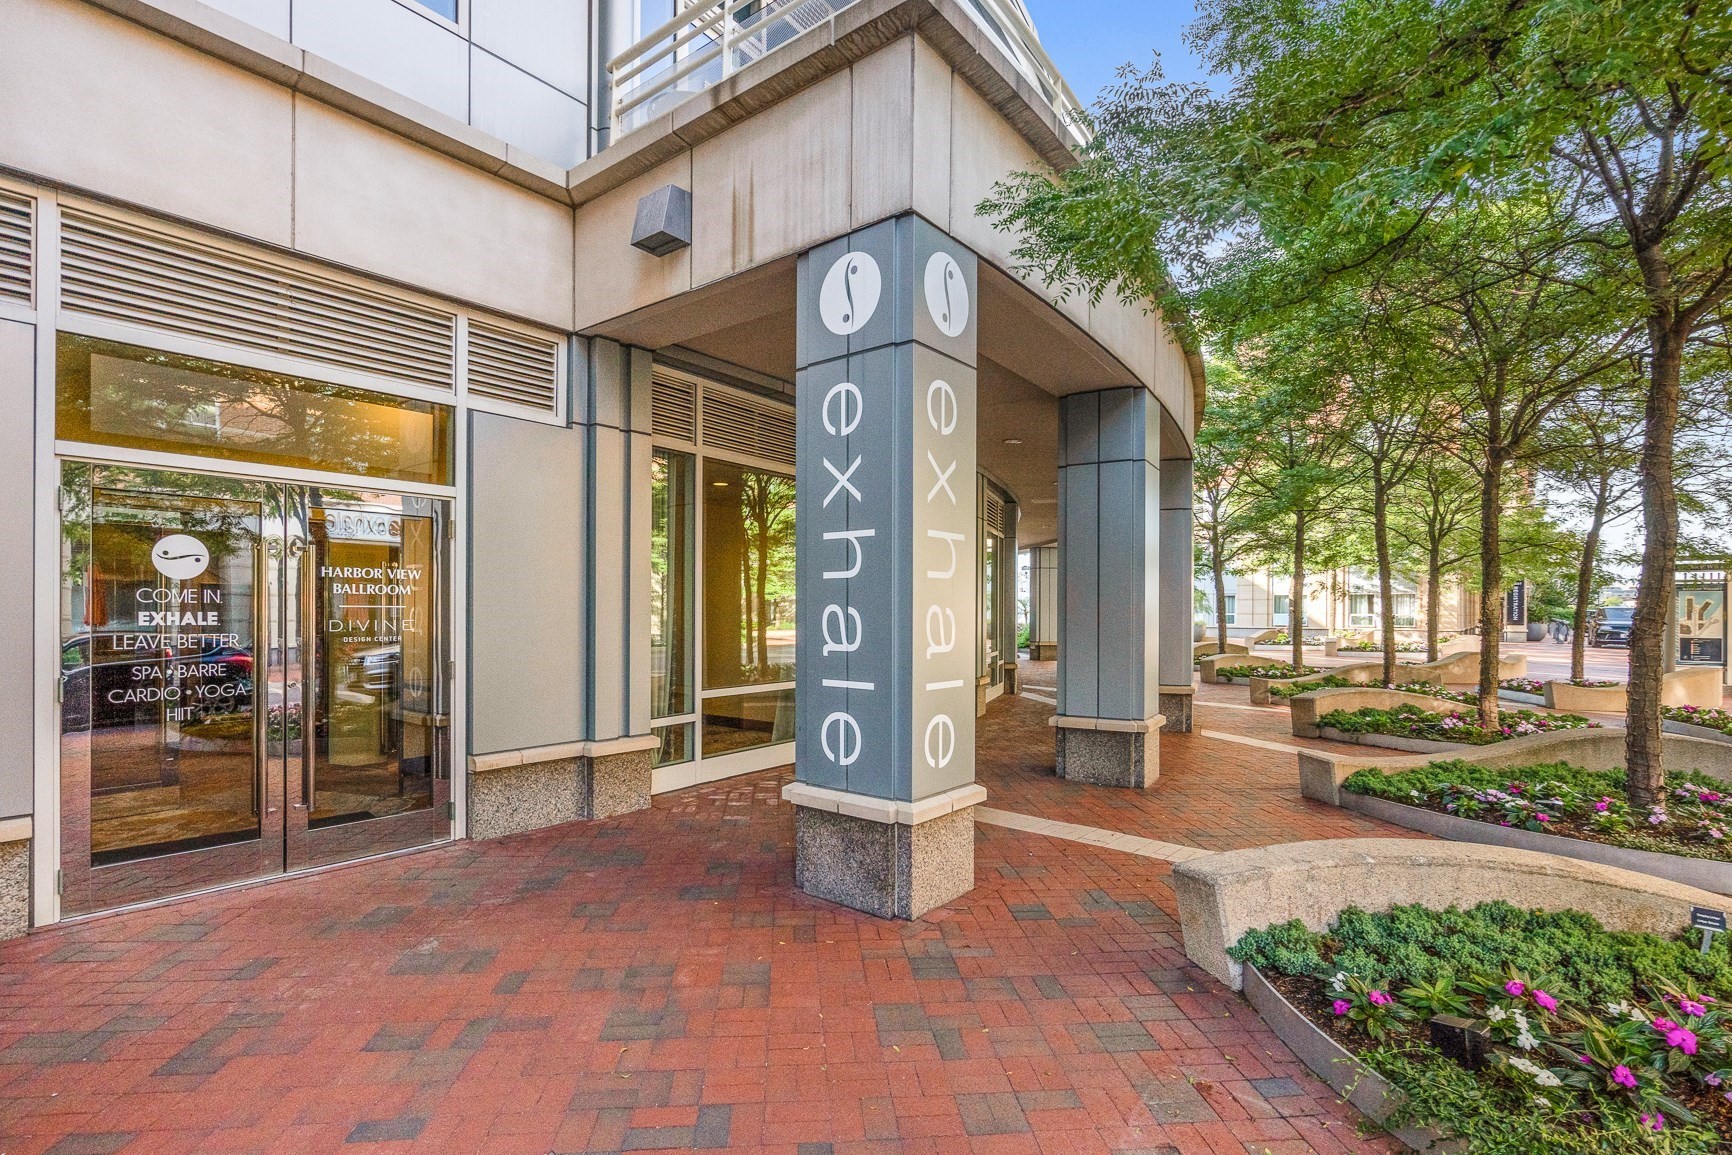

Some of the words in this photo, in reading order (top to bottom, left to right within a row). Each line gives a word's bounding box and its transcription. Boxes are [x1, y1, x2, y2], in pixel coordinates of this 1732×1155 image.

[321, 566, 383, 579] HARBOR
[387, 568, 422, 580] VIEW
[821, 382, 875, 766] exhale
[925, 379, 965, 769] exhale
[136, 587, 198, 604] COME
[203, 589, 223, 604] IN.
[333, 583, 412, 595] BALLROOM
[138, 611, 221, 626] EXHALE.
[329, 619, 415, 632] DIVINE
[113, 634, 172, 650] LEAVE
[177, 633, 242, 649] BETTER.
[132, 665, 163, 680] SPA
[178, 663, 227, 678] BARRE
[108, 686, 181, 704] CARDIO
[195, 683, 247, 698] YOGA
[166, 706, 195, 721] HIIT
